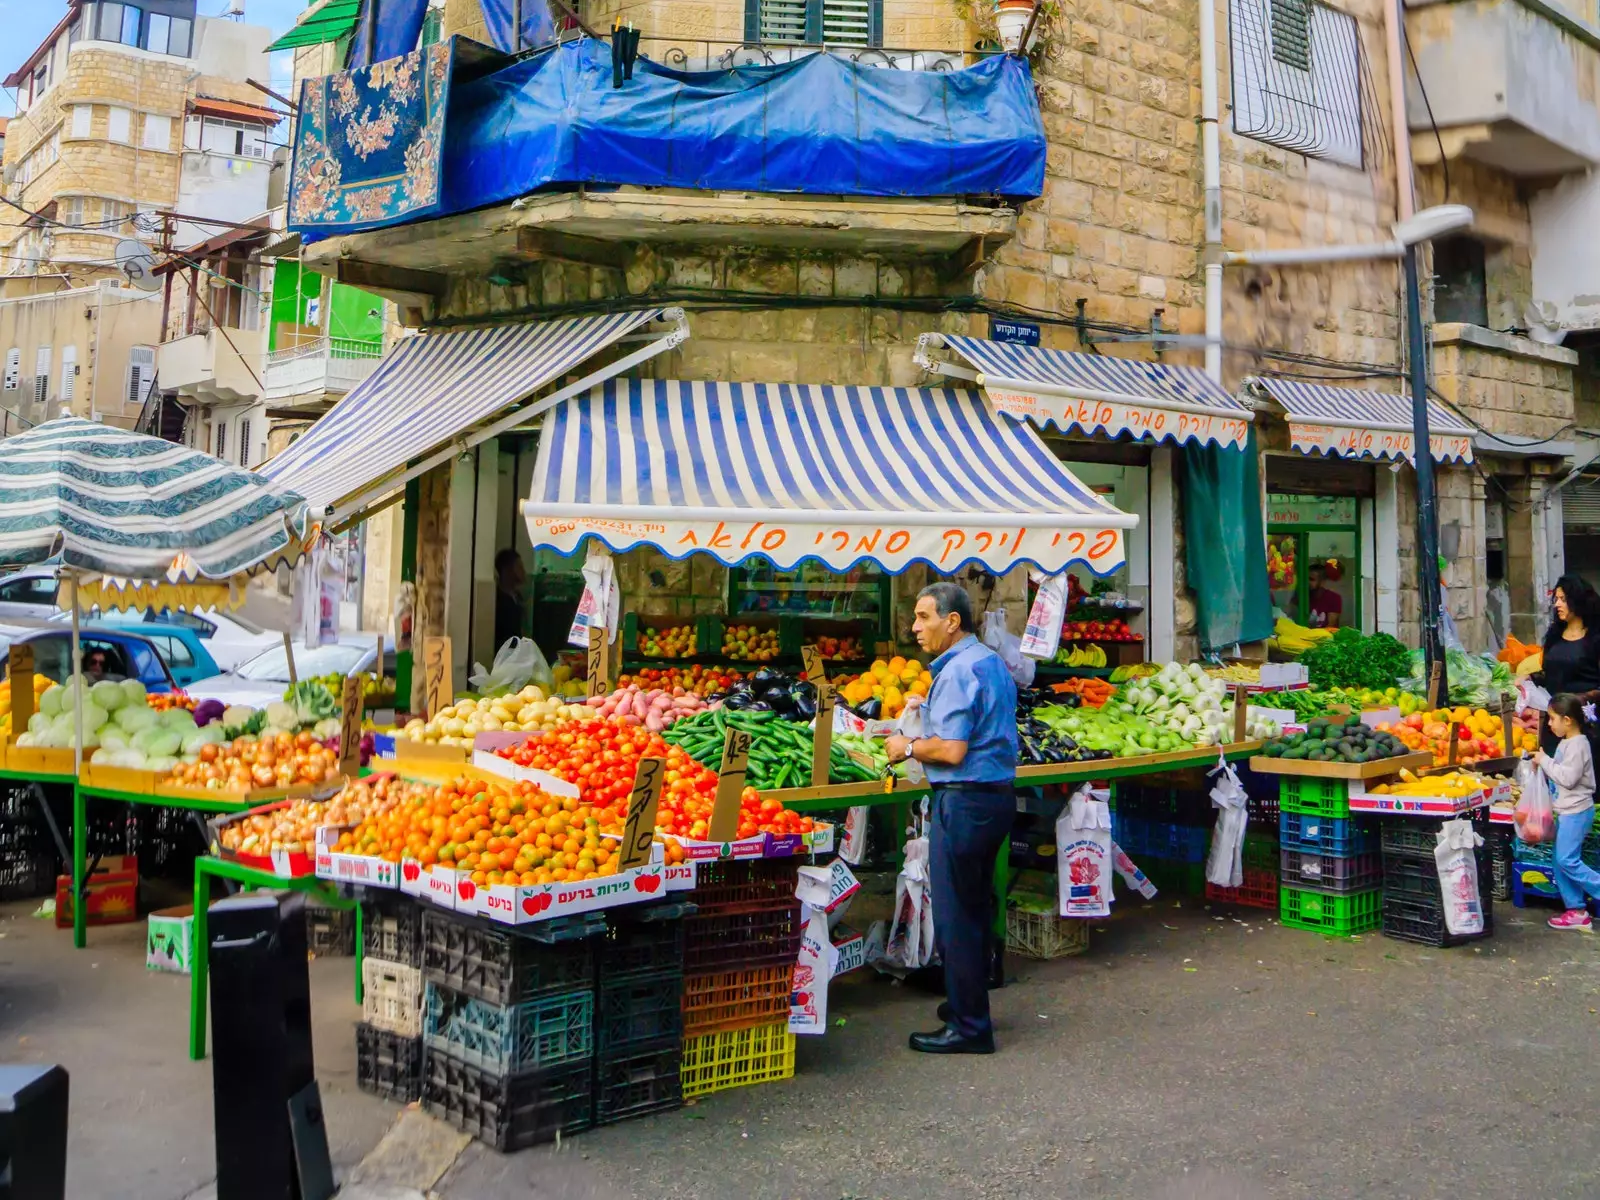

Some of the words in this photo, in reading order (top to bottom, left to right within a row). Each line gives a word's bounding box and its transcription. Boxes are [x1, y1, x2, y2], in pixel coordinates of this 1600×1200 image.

[1063, 399, 1113, 425] סלאח
[1125, 411, 1165, 430] סמרי
[1178, 414, 1213, 438] וירק
[1222, 419, 1247, 441] פרי
[1339, 428, 1373, 449] סלאח
[1381, 434, 1411, 451] סמרי
[1450, 436, 1469, 456] פרי
[677, 520, 787, 551] סלאח
[814, 528, 910, 554] סמרי
[939, 527, 1026, 564] וירק
[1052, 529, 1118, 560] פרי
[633, 758, 660, 794] 3
[622, 812, 653, 865] 10
[430, 877, 452, 894] ברעם
[558, 888, 595, 904] ברעם
[597, 880, 630, 896] פירות
[488, 895, 513, 912] ברעם
